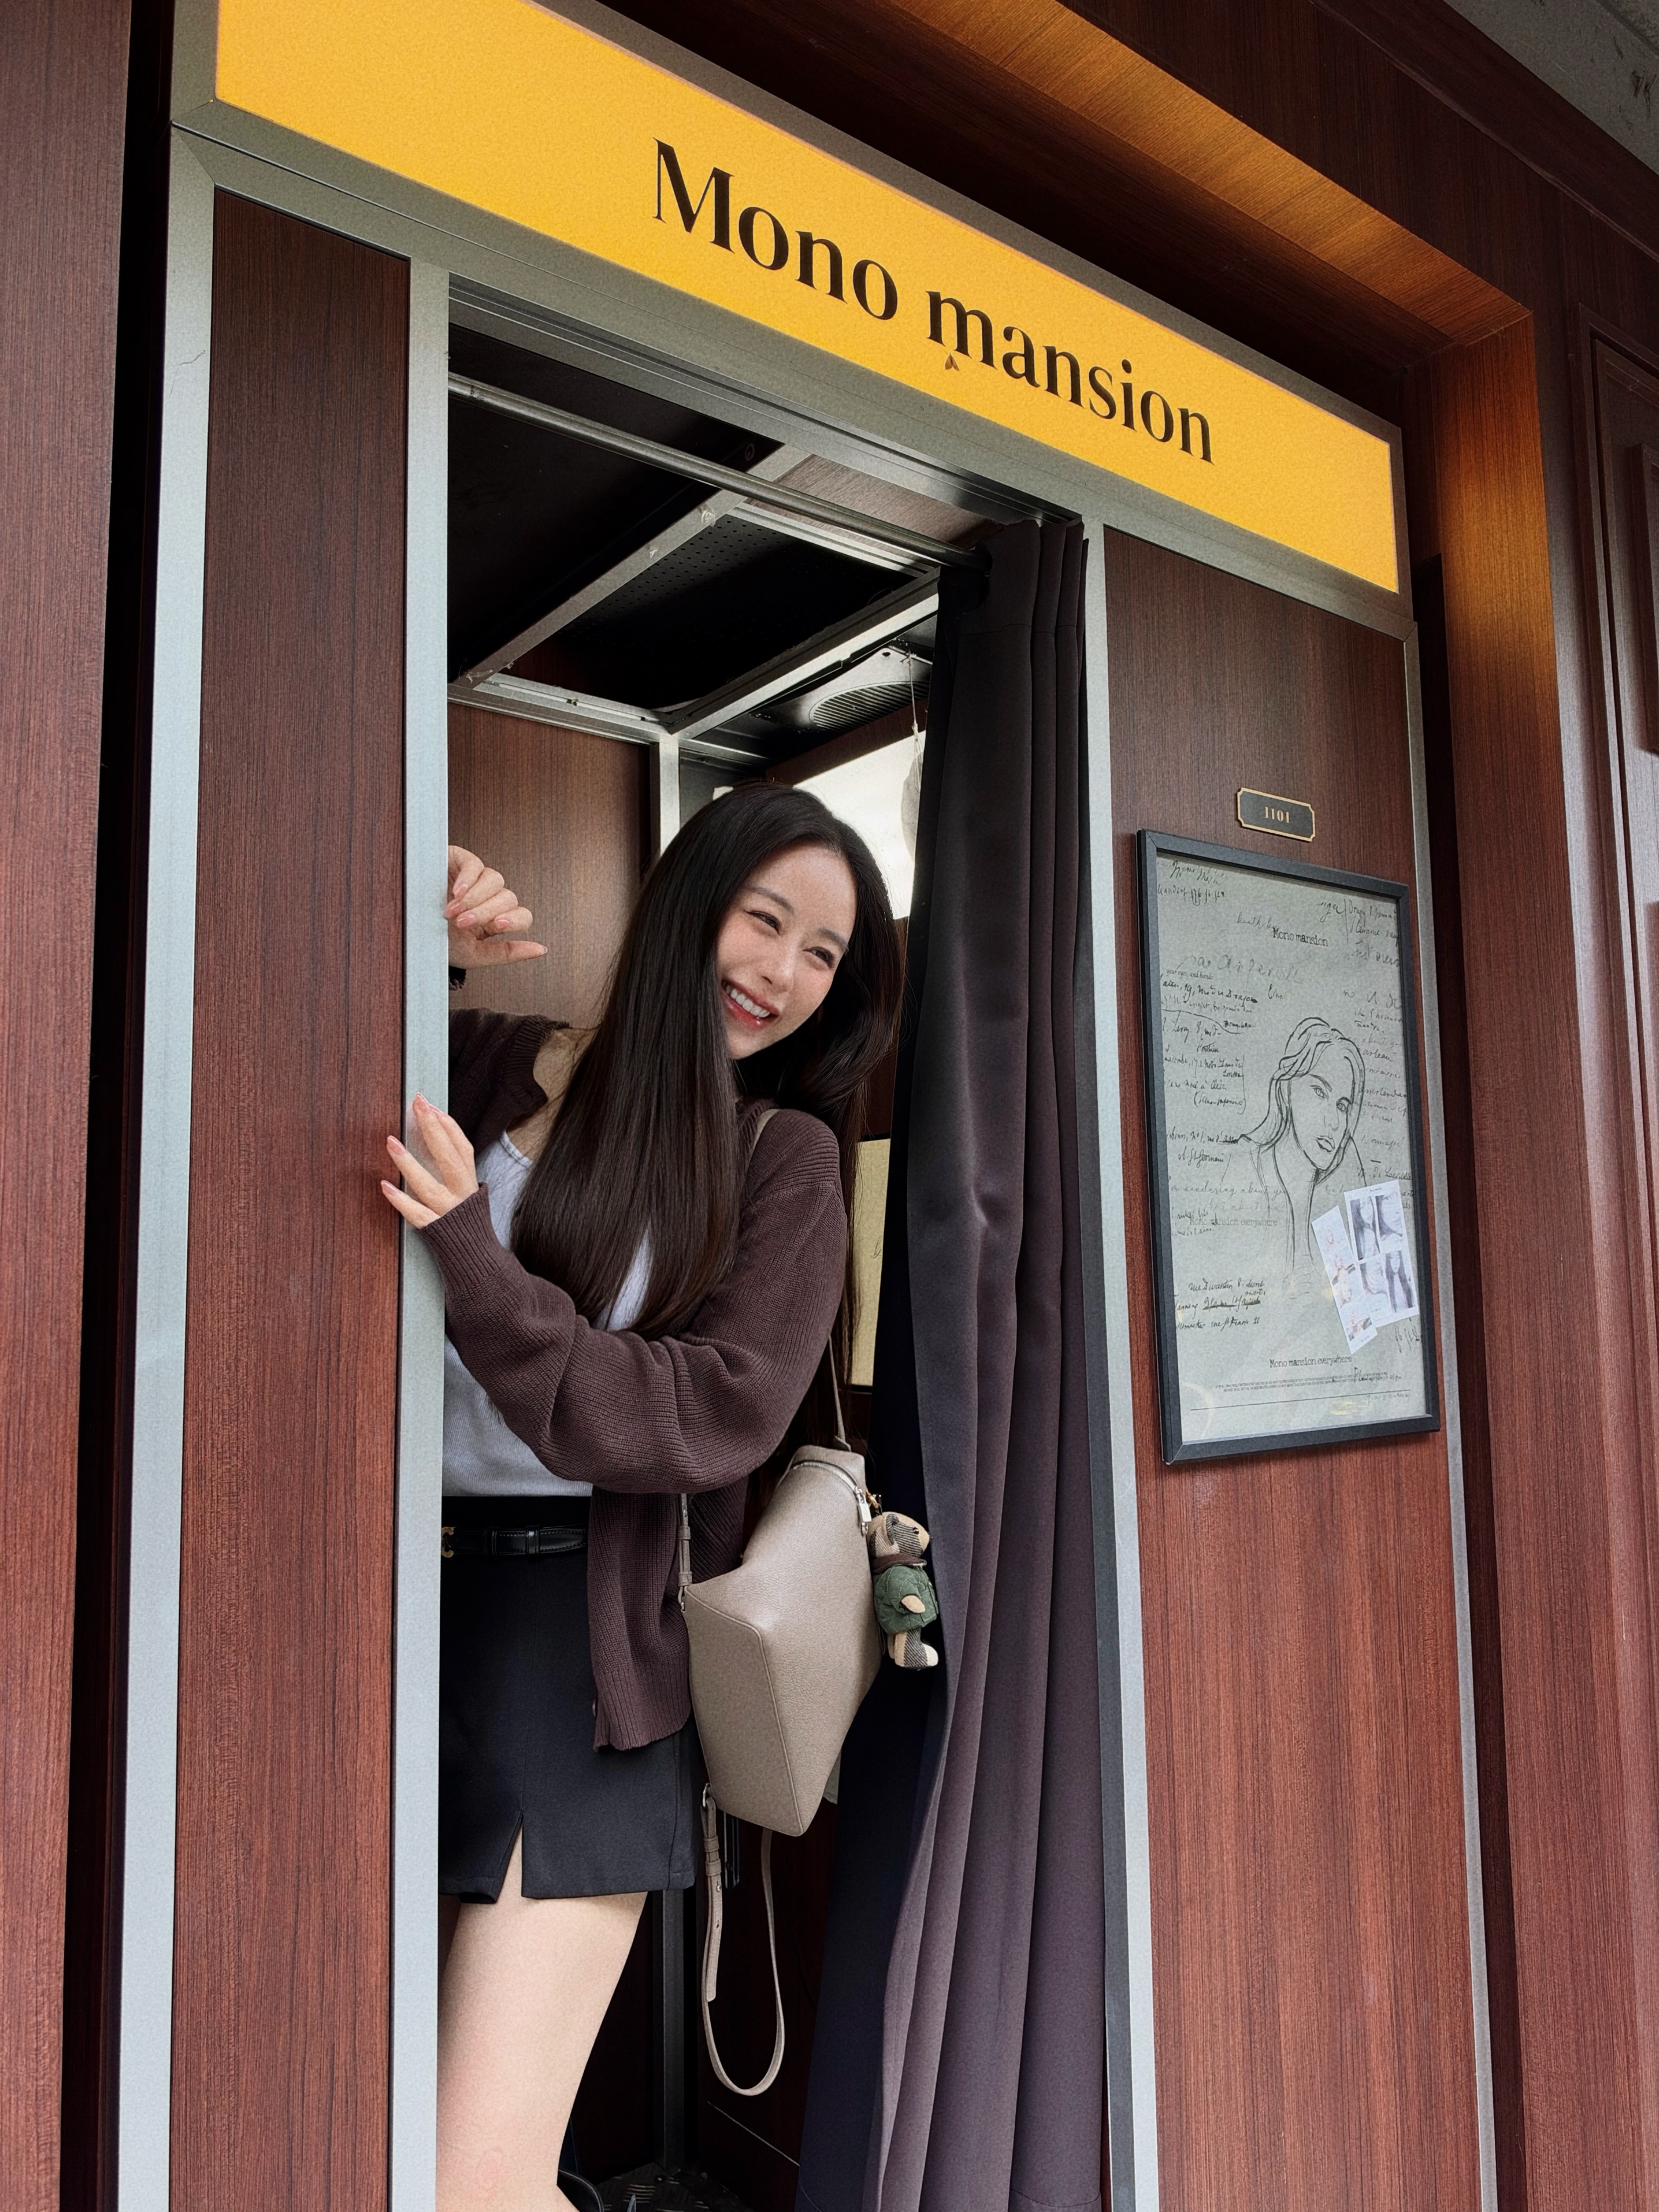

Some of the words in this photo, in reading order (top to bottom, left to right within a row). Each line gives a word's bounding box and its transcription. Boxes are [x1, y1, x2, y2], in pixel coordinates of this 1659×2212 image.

[652, 136, 898, 321] Mono
[926, 288, 1215, 466] mansion
[1264, 806, 1290, 824] 1101
[1272, 927, 1294, 941] Mono
[1296, 934, 1328, 947] mansion
[1165, 969, 1177, 977] your
[1199, 971, 1214, 980] hands
[1242, 1218, 1278, 1228] everywhere
[1269, 1359, 1287, 1368] Mono
[1289, 1357, 1317, 1367] mansion
[1318, 1354, 1352, 1366] everywhere
